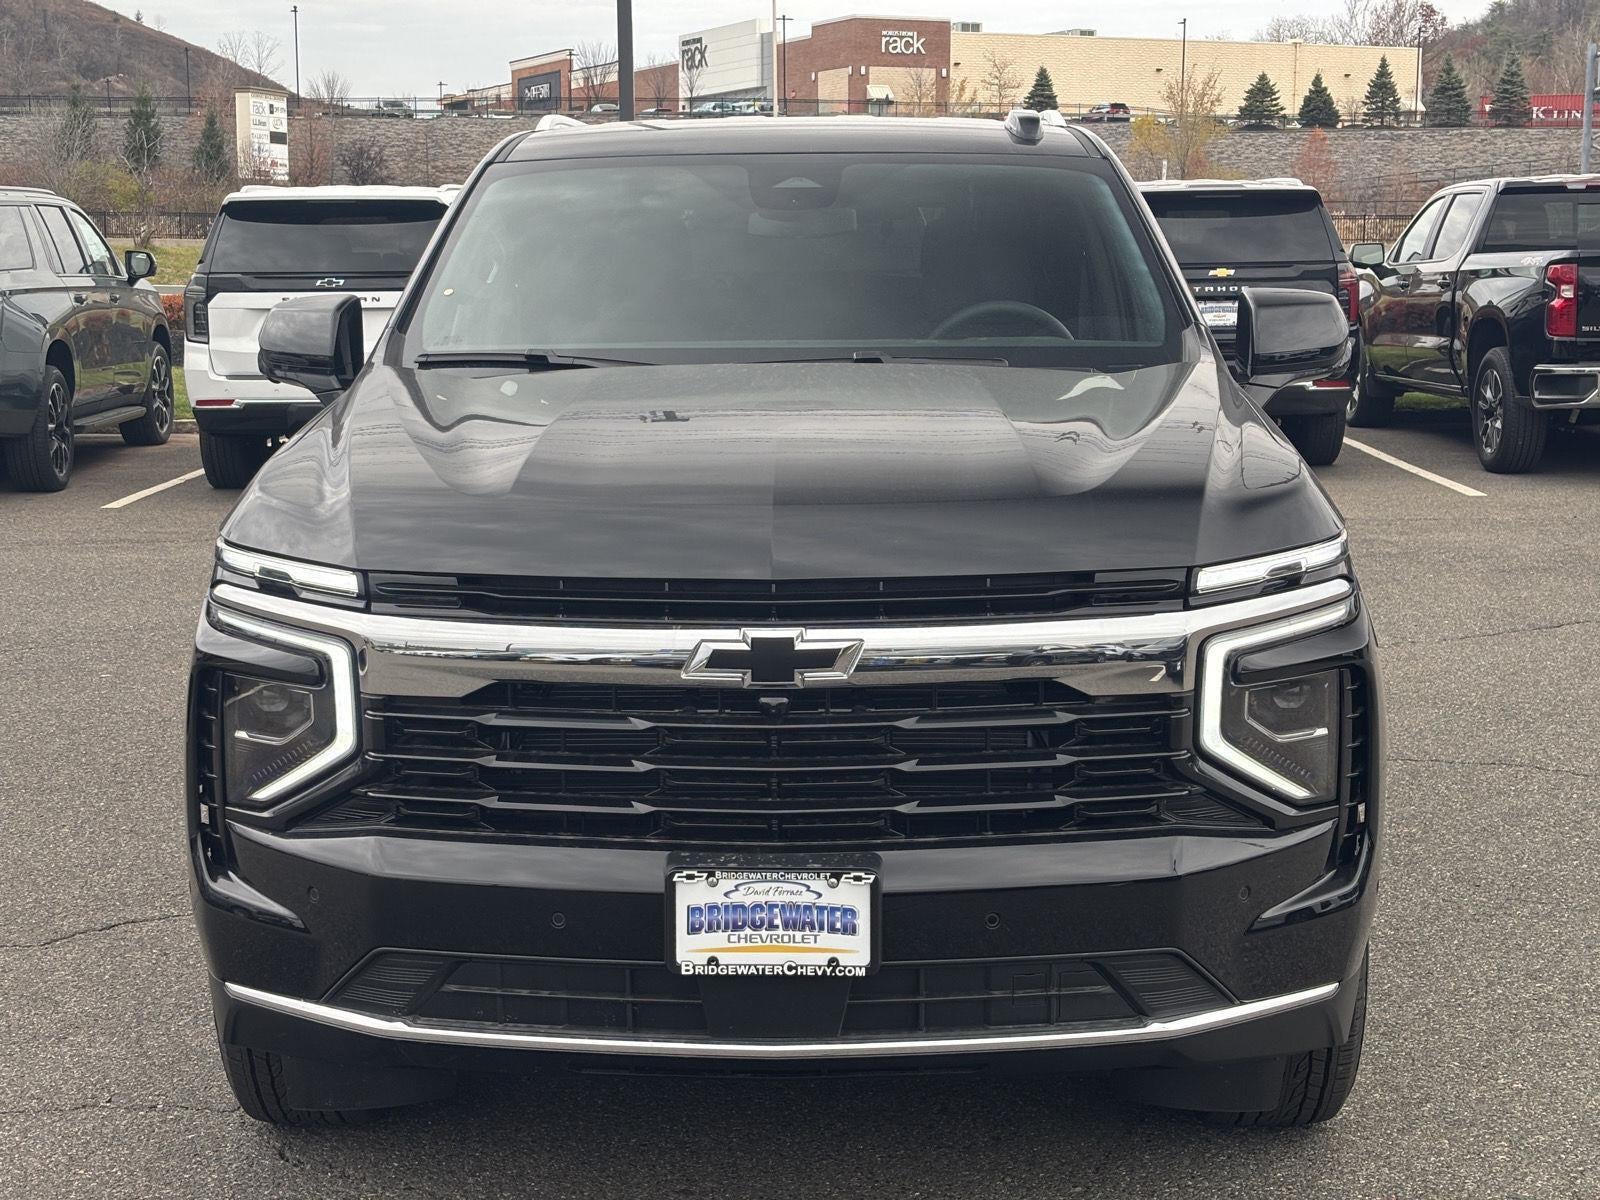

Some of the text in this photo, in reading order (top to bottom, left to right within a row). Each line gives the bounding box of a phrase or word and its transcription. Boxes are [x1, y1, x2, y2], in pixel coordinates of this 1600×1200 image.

[881, 31, 926, 55] rack
[681, 37, 709, 71] rack
[252, 102, 267, 117] rack
[743, 886, 772, 897] David
[687, 902, 860, 936] BRIDGEWATER
[727, 933, 821, 944] CHEVROLET
